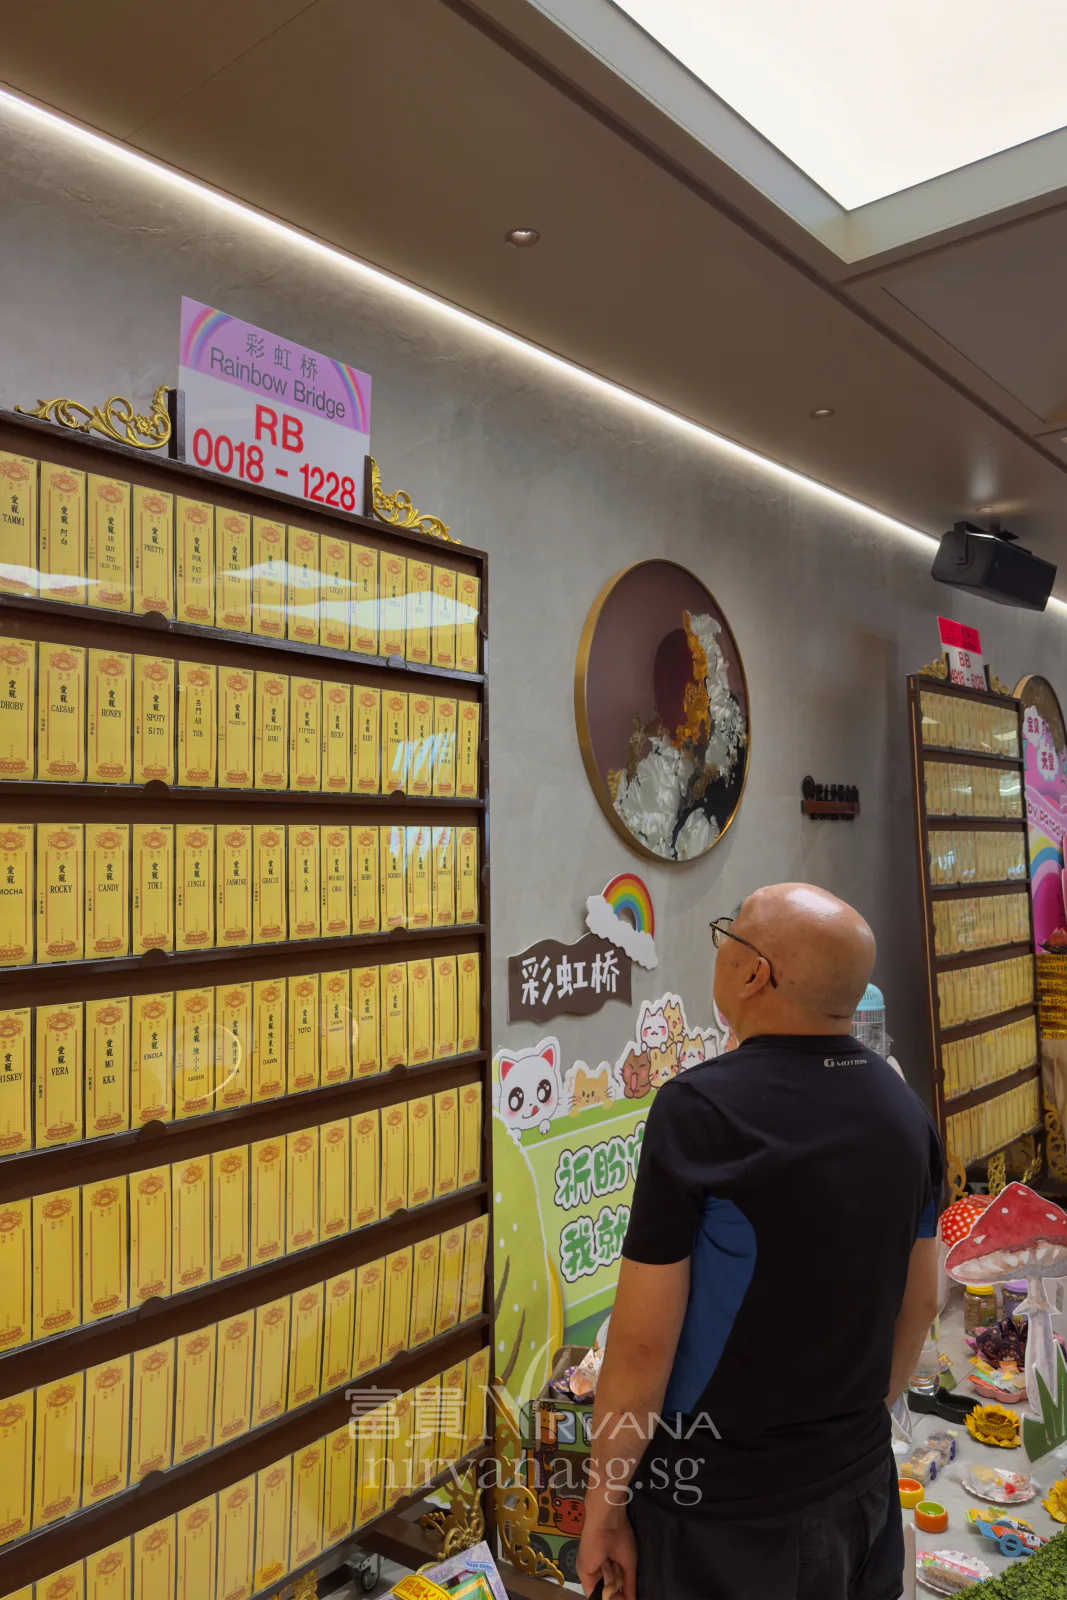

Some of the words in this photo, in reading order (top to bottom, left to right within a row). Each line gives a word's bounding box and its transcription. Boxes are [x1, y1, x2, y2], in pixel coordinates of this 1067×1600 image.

[245, 333, 319, 382] 彩虹桥
[210, 346, 288, 396] Rainbow
[293, 378, 346, 420] Bridge
[255, 404, 305, 454] RB
[193, 428, 264, 483] 0018
[300, 463, 356, 511] 1228
[0, 700, 24, 711] DHOBY
[51, 704, 75, 714] CAESAR
[101, 708, 123, 719] HONEY
[146, 713, 166, 723] SPOTY
[50, 884, 73, 894] ROCKY
[98, 883, 120, 893] CANDY
[147, 881, 163, 890] TOKI
[521, 950, 620, 1006] 彩虹桥
[143, 1052, 163, 1060] ENOLA
[104, 1060, 114, 1068] MO
[51, 1066, 69, 1076] VERA
